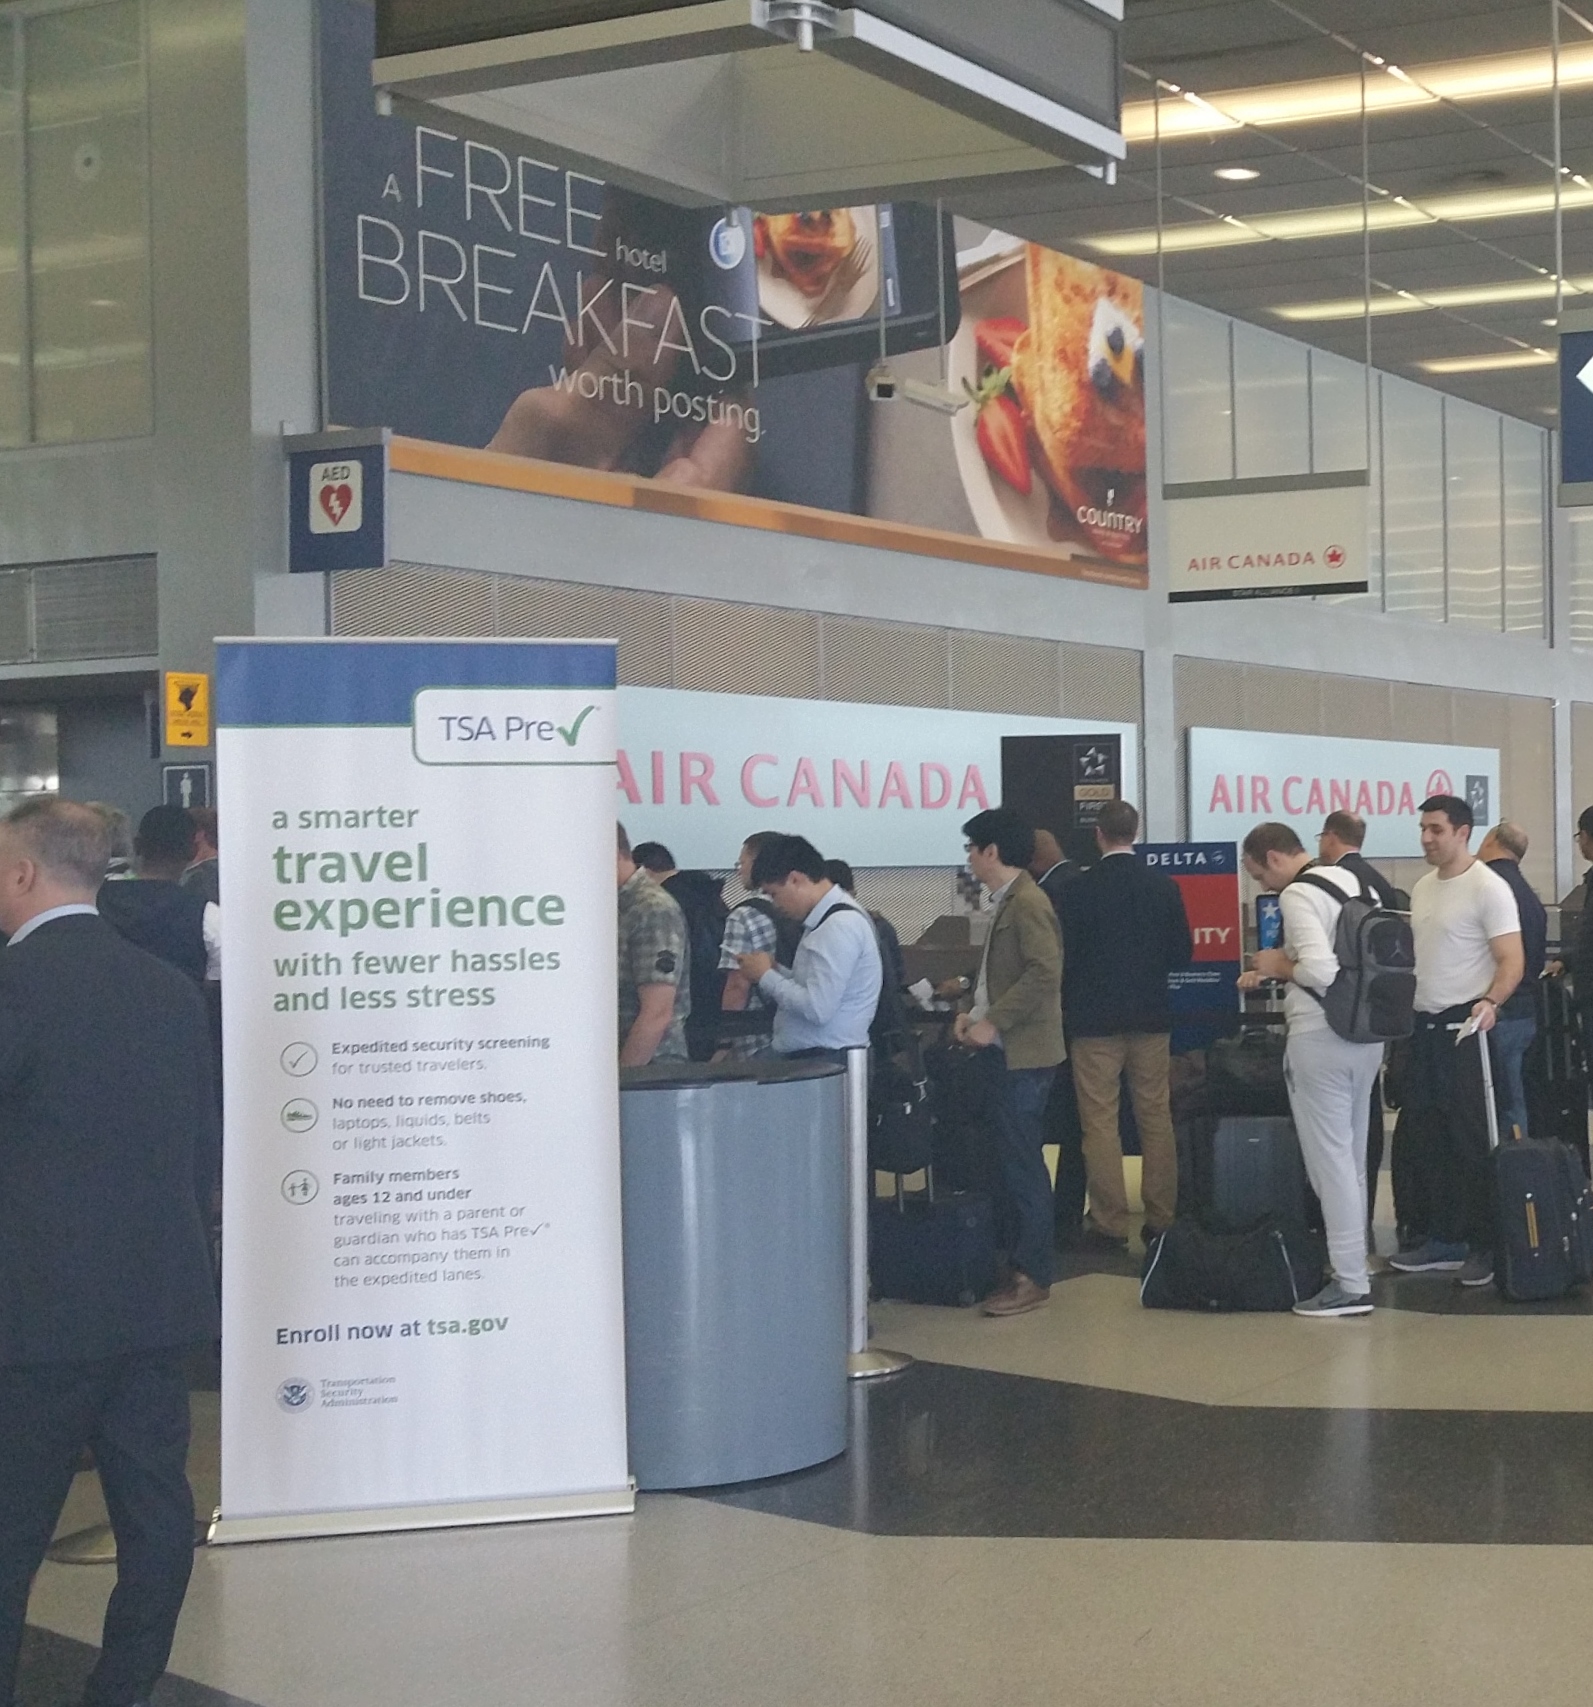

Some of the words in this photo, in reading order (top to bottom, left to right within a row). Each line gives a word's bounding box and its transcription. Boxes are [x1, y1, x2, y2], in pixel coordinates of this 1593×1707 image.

[381, 175, 402, 203] A
[412, 125, 608, 258] FREE
[615, 236, 668, 276] hotel
[356, 215, 773, 390] BREAKFAST
[549, 361, 644, 412] worth
[653, 387, 767, 445] posting.
[321, 465, 351, 482] AED
[1077, 505, 1144, 534] COUNTRY
[1188, 557, 1222, 572] AIR
[1227, 551, 1315, 569] CANADA
[439, 716, 496, 741] TSA
[617, 748, 720, 806] AIR
[741, 753, 990, 810] CANADA
[1208, 774, 1273, 814] AIR
[1282, 776, 1416, 815] CANADA
[273, 811, 288, 829] a
[299, 806, 418, 829] smarter
[273, 843, 428, 884] travel
[1147, 852, 1207, 866] DELTA
[274, 888, 565, 937] experience
[274, 952, 341, 977] with
[352, 951, 440, 975] fewer
[451, 948, 560, 973] hassles
[274, 986, 329, 1012] and
[342, 986, 396, 1010] less
[407, 984, 496, 1008] stress
[332, 1041, 408, 1056] Expedited
[412, 1039, 474, 1054] security
[478, 1036, 550, 1051] screening
[332, 1061, 353, 1075] for
[359, 1059, 412, 1074] trusted
[417, 1057, 487, 1073] travelers.
[333, 1096, 353, 1110] No
[357, 1094, 394, 1109] need
[399, 1094, 414, 1107] to
[418, 1093, 476, 1106] remove
[454, 1111, 491, 1125] belts
[333, 1139, 348, 1151] or
[354, 1135, 387, 1151] light
[333, 1171, 384, 1186] Family
[389, 1168, 460, 1182] members
[333, 1193, 368, 1207] ages
[373, 1190, 391, 1204] 12
[395, 1189, 423, 1203] and
[427, 1187, 472, 1201] under
[334, 1210, 400, 1227] traveling
[405, 1209, 439, 1223] with
[443, 1211, 452, 1222] a
[457, 1207, 505, 1223] parent
[510, 1206, 525, 1217] or
[334, 1232, 400, 1249] guardian
[404, 1229, 437, 1243] who
[441, 1228, 467, 1242] has
[471, 1226, 499, 1240] TSA
[334, 1255, 360, 1268] can
[364, 1251, 449, 1267] accompany
[453, 1246, 492, 1261] them
[496, 1246, 511, 1259] in
[334, 1273, 359, 1288] the
[362, 1270, 438, 1287] expedited
[275, 1323, 341, 1345] Enroll
[347, 1324, 394, 1340] now
[400, 1319, 421, 1338] at
[427, 1316, 509, 1336] tsa.gov
